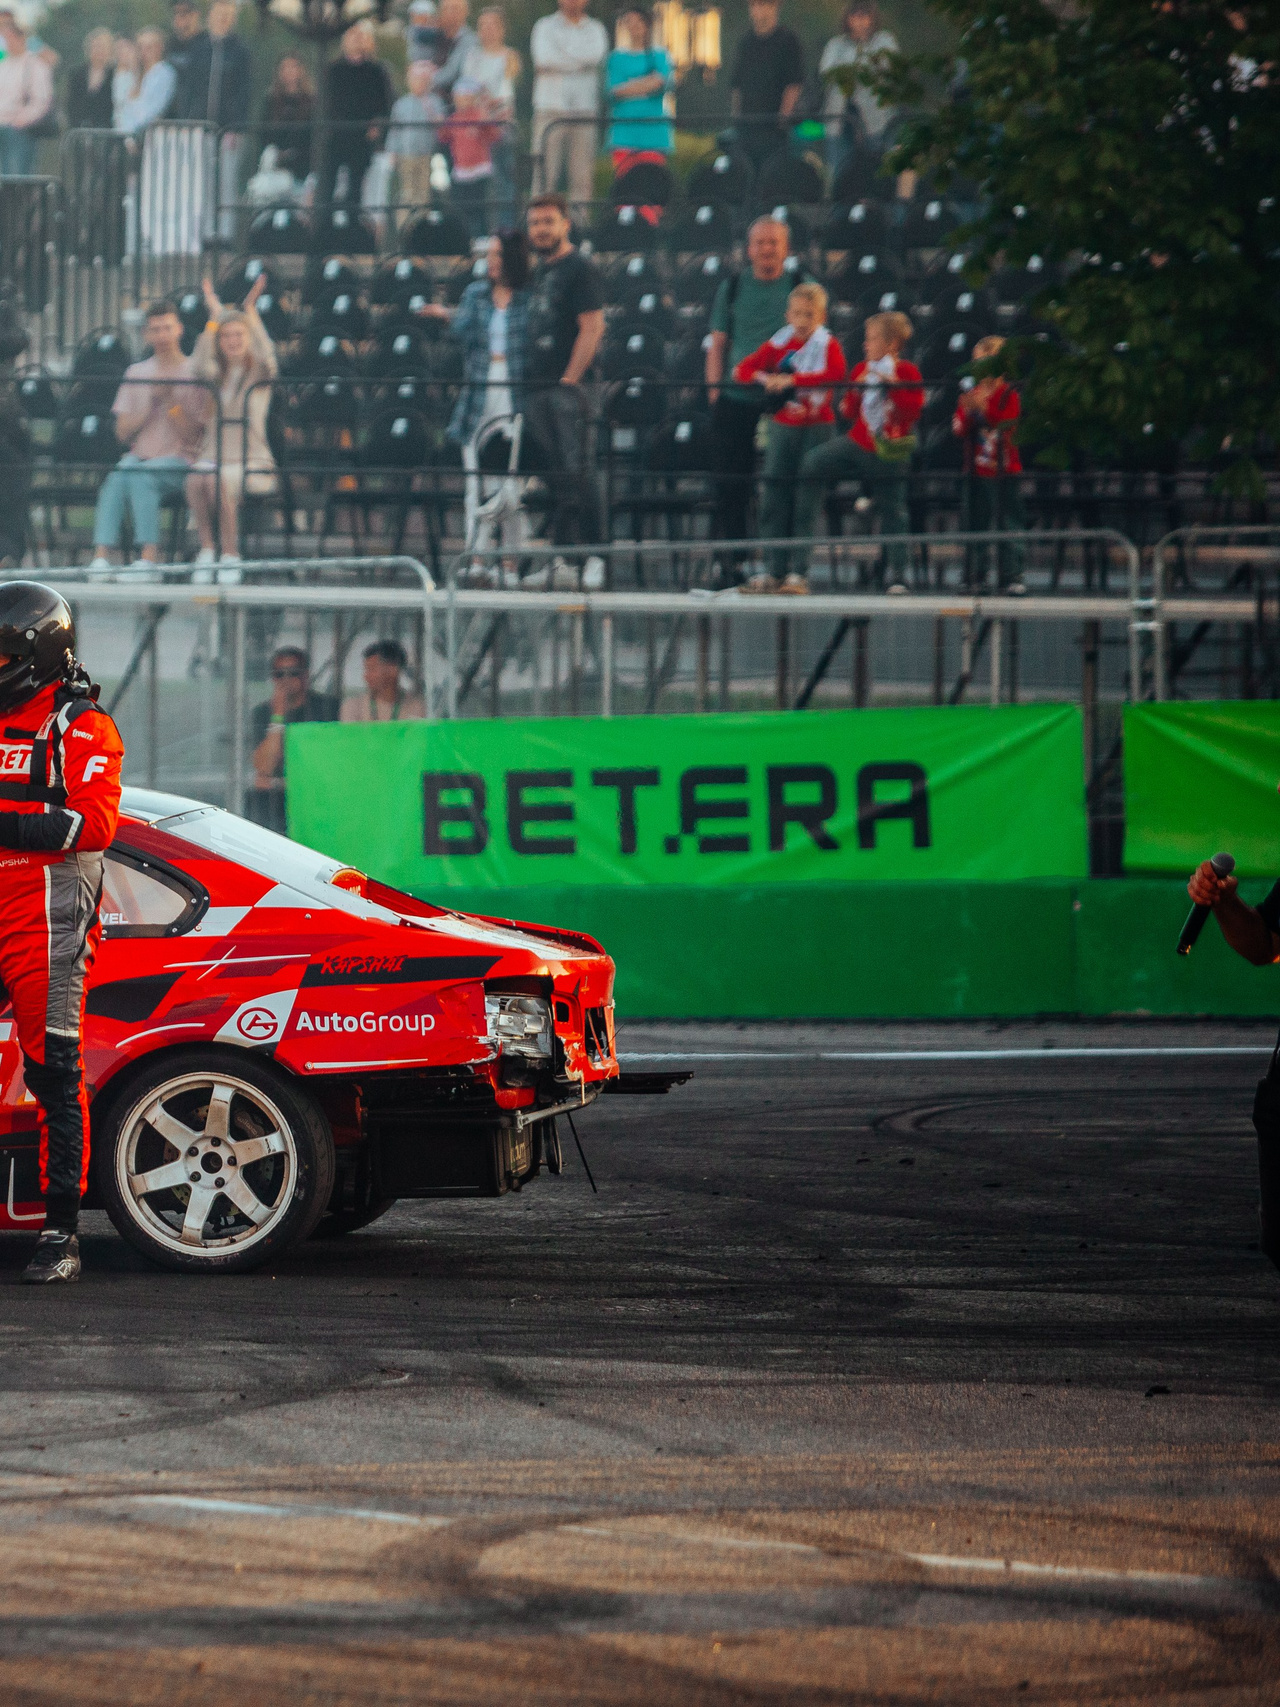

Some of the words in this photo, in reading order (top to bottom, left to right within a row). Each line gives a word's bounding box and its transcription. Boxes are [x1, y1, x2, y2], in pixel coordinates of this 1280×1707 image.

[82, 755, 108, 782] F
[99, 912, 128, 924] VEL
[321, 954, 408, 974] KAPSHAI
[296, 1011, 436, 1036] AutoGroup
